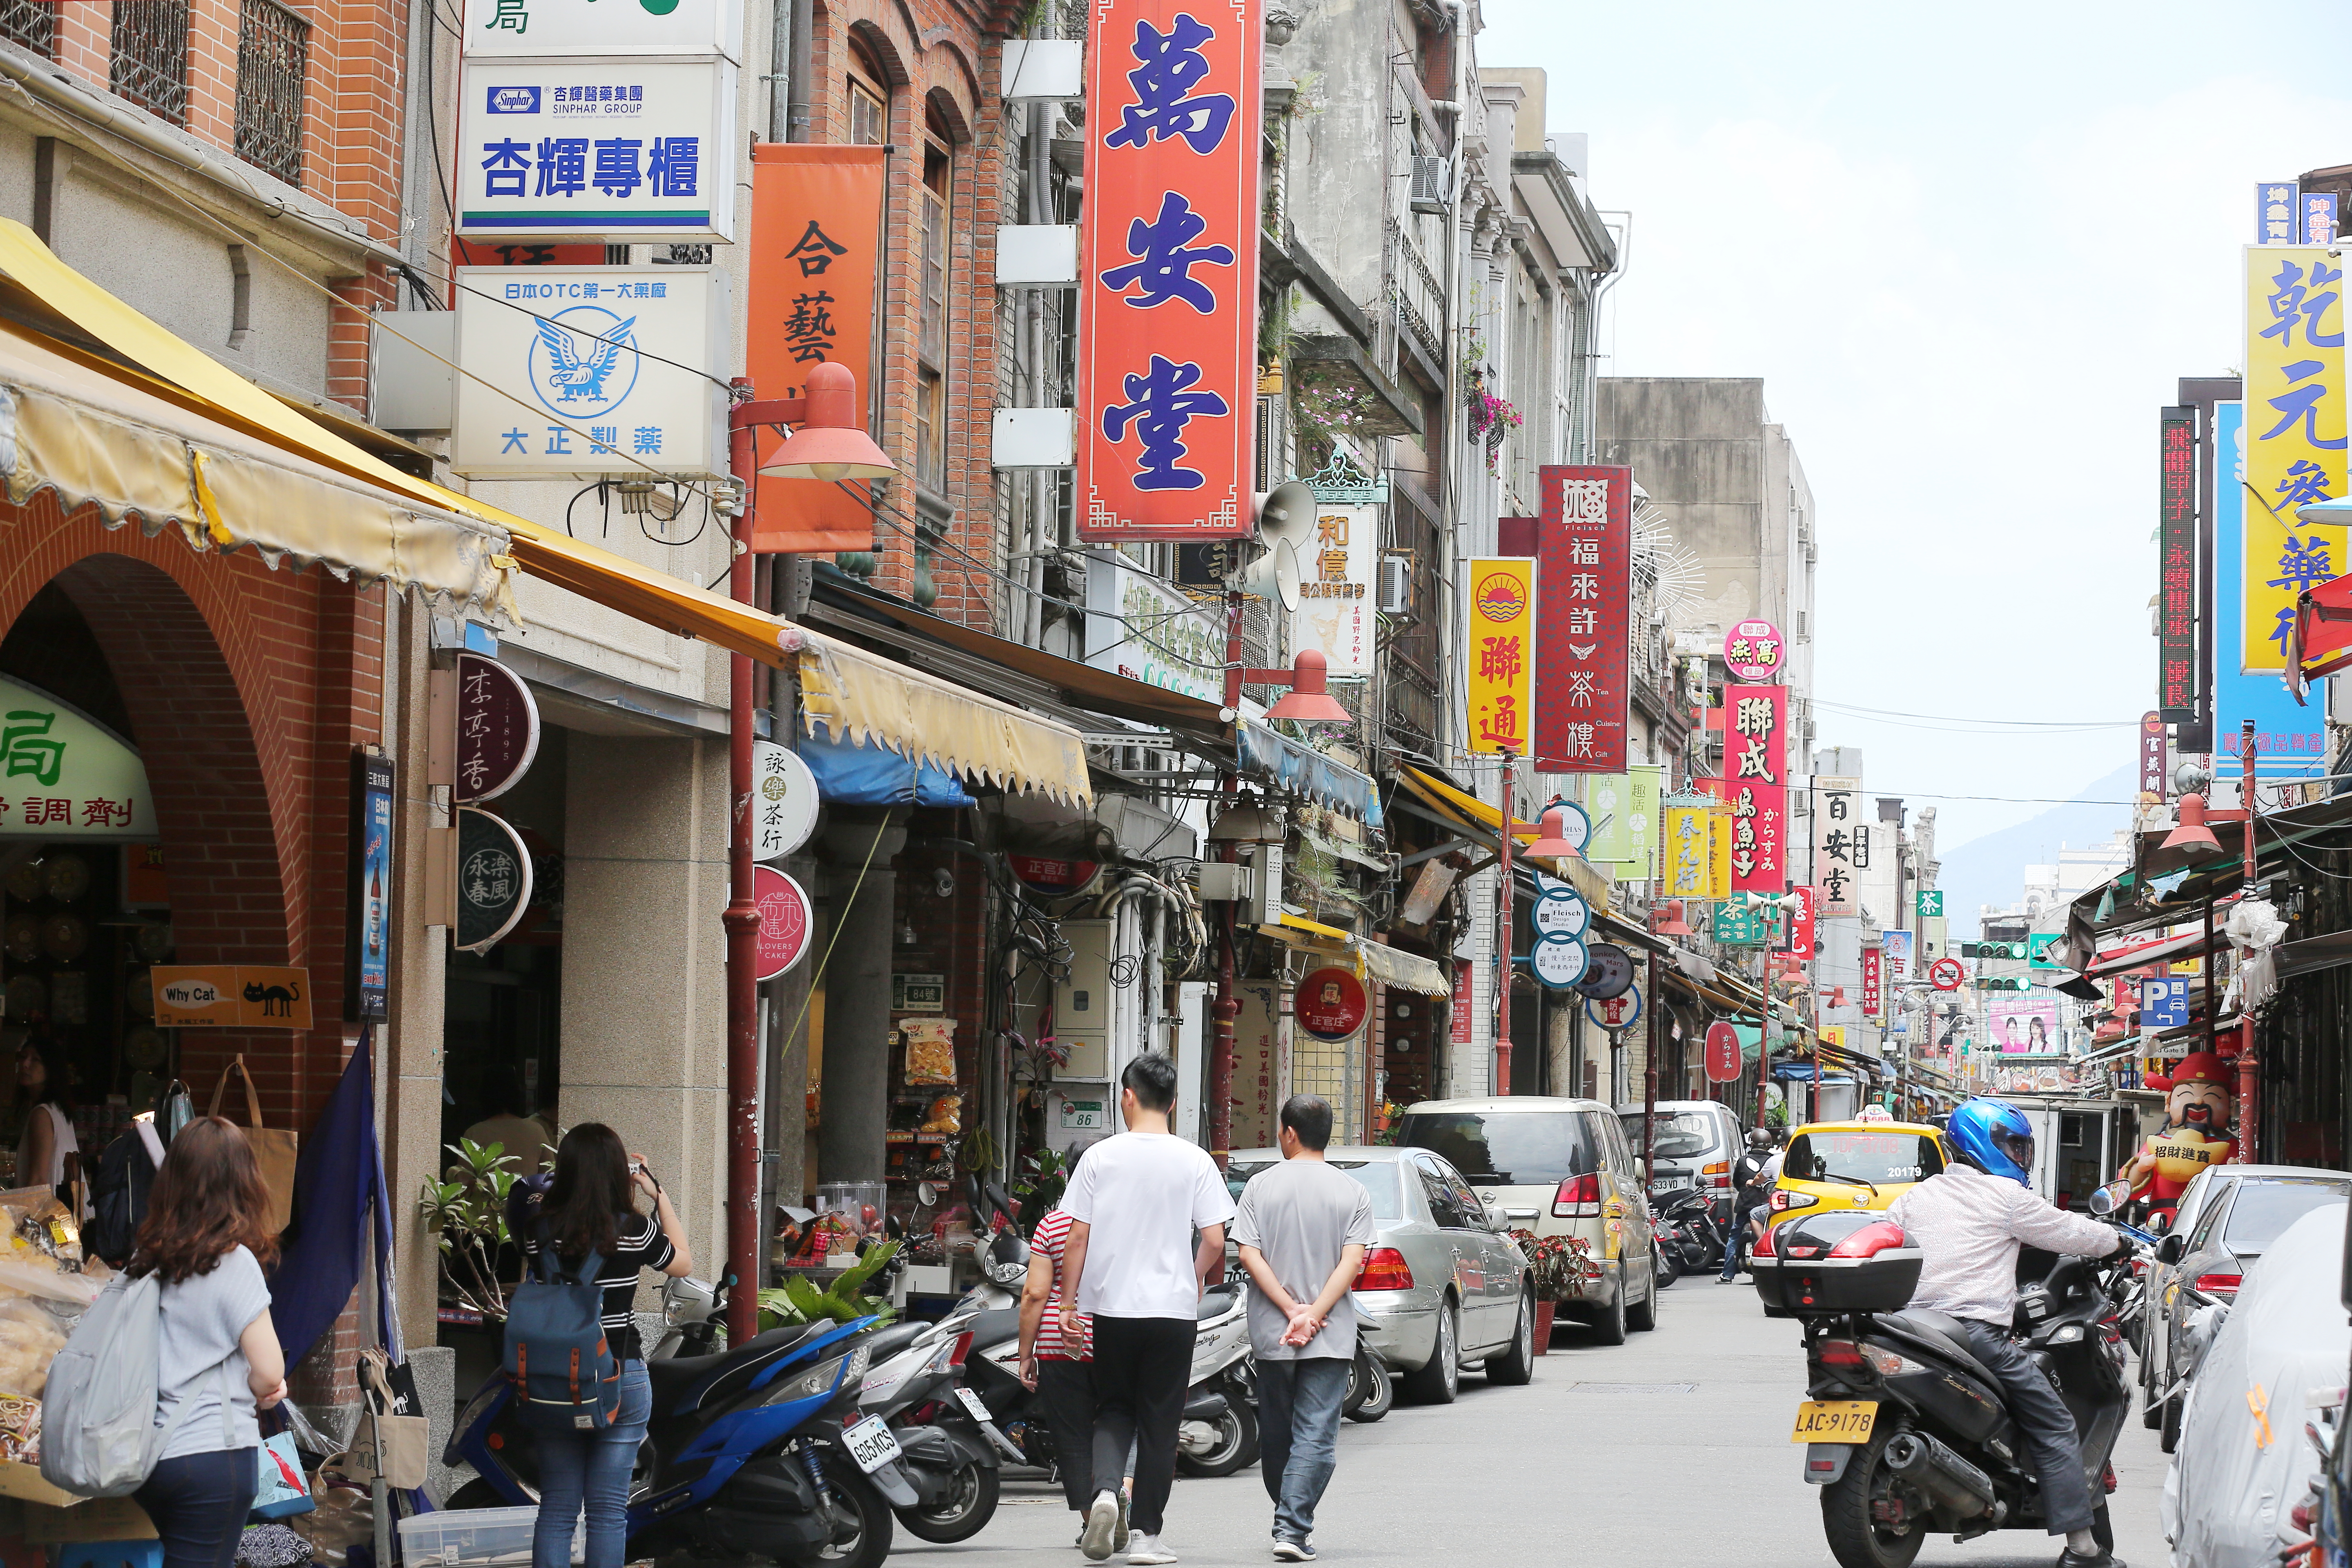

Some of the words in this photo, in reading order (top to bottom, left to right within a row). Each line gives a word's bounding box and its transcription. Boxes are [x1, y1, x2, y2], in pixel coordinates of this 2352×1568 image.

[498, 89, 531, 109] Sinphar
[554, 85, 643, 102] 杏輝醫藥集團
[553, 104, 597, 114] SINPHAR
[604, 104, 642, 114] GROUP
[481, 137, 699, 198] 杏輝專櫃
[2309, 198, 2330, 244] 坤益有
[1100, 13, 1237, 492] 萬安堂
[1316, 514, 1349, 581] 和億
[1569, 537, 1599, 635] 福來許
[1743, 624, 1767, 636] 聯成
[1729, 638, 1779, 666] 燕窩
[1745, 666, 1763, 676] 極品
[1480, 636, 1524, 746] 聯通
[1735, 697, 1775, 784] 聯成
[2223, 733, 2323, 752] 嚴極品特產
[762, 752, 786, 852] 詠樂茶行
[1733, 786, 1757, 878] 烏魚子
[1760, 807, 1780, 871] からすみ
[1676, 814, 1700, 891] 春元行
[1822, 791, 1853, 902] 百安堂
[1719, 895, 1748, 921] 茶
[1918, 891, 1942, 915] 茶
[165, 987, 189, 1002] Why
[193, 987, 215, 1001] Cat
[913, 988, 935, 1000] 84號
[2143, 981, 2169, 1011] P
[1311, 1015, 1345, 1027] 正官庄
[1723, 1034, 1733, 1069] からすみ
[1077, 1114, 1092, 1125] 86
[2155, 1145, 2211, 1164] 招財進寶
[1887, 1166, 1922, 1178] 20179
